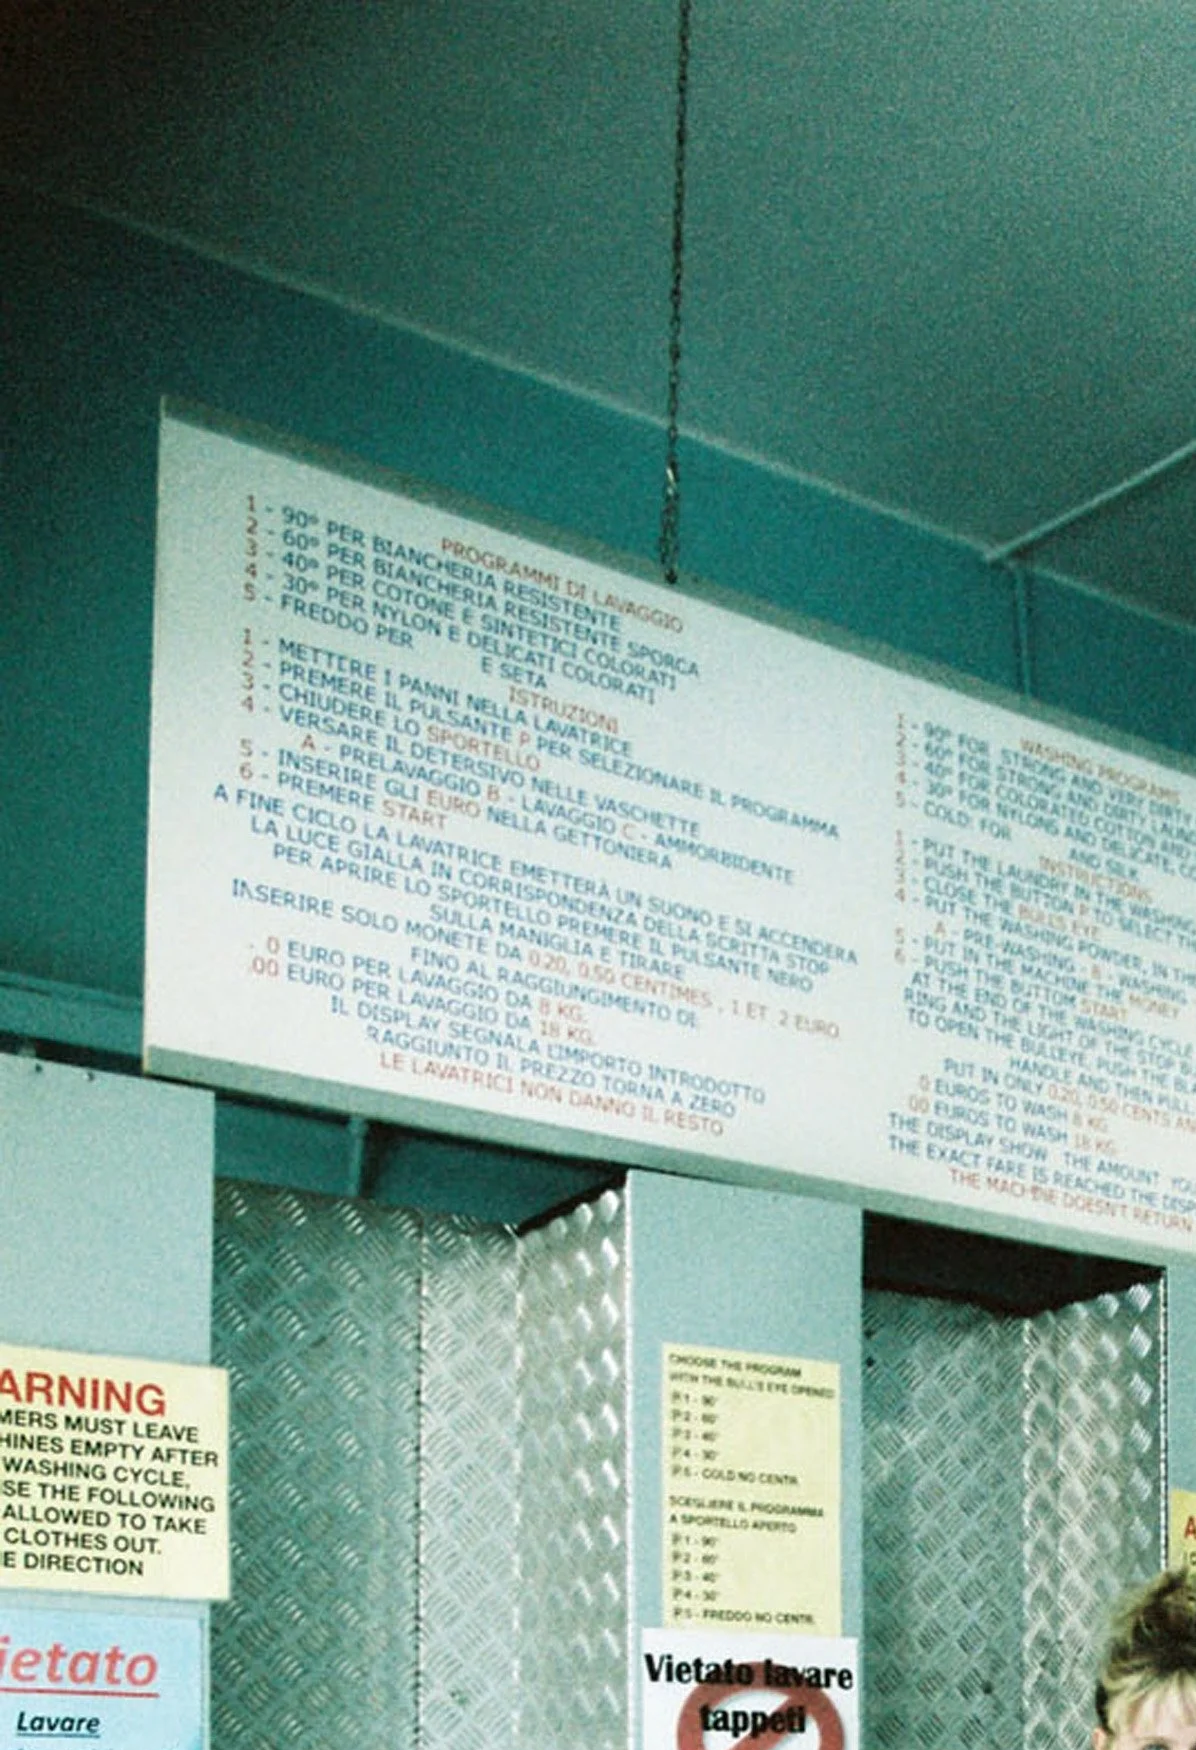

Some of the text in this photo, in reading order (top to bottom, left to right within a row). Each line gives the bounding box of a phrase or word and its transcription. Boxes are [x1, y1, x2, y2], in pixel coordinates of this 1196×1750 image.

[441, 536, 683, 634] PROGRAMMI DI LAVAGGIO
[243, 627, 631, 757] 1 METTERE I PANNI NELLA LAVATRICE
[241, 671, 539, 772] 3 CHIUDERE LO SPORTELLO
[242, 648, 839, 839] 2 PREMERE IL PULSANTE P PER SELEZIONARE IL PROGRAMMA
[240, 693, 699, 837] 4 VERSARE IL DETERSIVO NELLE VASCHETTE
[239, 738, 671, 870] 5 INSERIRE GLI EURO NELLA GETTONIERA
[923, 837, 954, 860] PUT
[961, 849, 989, 870] THE
[1074, 883, 1088, 900] IN
[1096, 890, 1121, 910] THE
[250, 814, 830, 976] LA LUCE GIALLA IN CORRISPONDENZA DELLA SCRITTA STOP
[272, 843, 813, 991] PER APRIRE LO SPORTELLO PREMERE IL PULSANTE NERO
[380, 1051, 722, 1134] LE LAVATRICI NON DANNO IL RESTO
[1009, 1056, 1071, 1083] HANDLE
[1076, 1072, 1108, 1092] AND
[1115, 1082, 1153, 1103] THEN
[950, 1168, 980, 1187] THE
[702, 1374, 723, 1387] THE
[721, 1358, 742, 1372] THE
[746, 1362, 802, 1378] PROGRAM
[65, 1415, 126, 1436] MUST
[133, 1421, 199, 1443] LEAVE
[71, 1438, 144, 1461] EMPTY
[151, 1447, 218, 1467] AFTER
[2, 1456, 190, 1490] WASHING CYCLE,
[38, 1482, 80, 1501] THE
[87, 1487, 216, 1513] FOLLOWING
[750, 1502, 824, 1518] PROGRAMMA
[2, 1504, 207, 1534] ALLOWED TO TAKE
[669, 1513, 797, 1533] A SPORTELLO APERTO
[4, 1527, 161, 1554] CLOTHES OUT.
[0, 1551, 143, 1576] E DIRECTION
[644, 1653, 853, 1689] Vietato lavare
[17, 1711, 100, 1733] Lavare
[701, 1703, 806, 1738] tappeti
